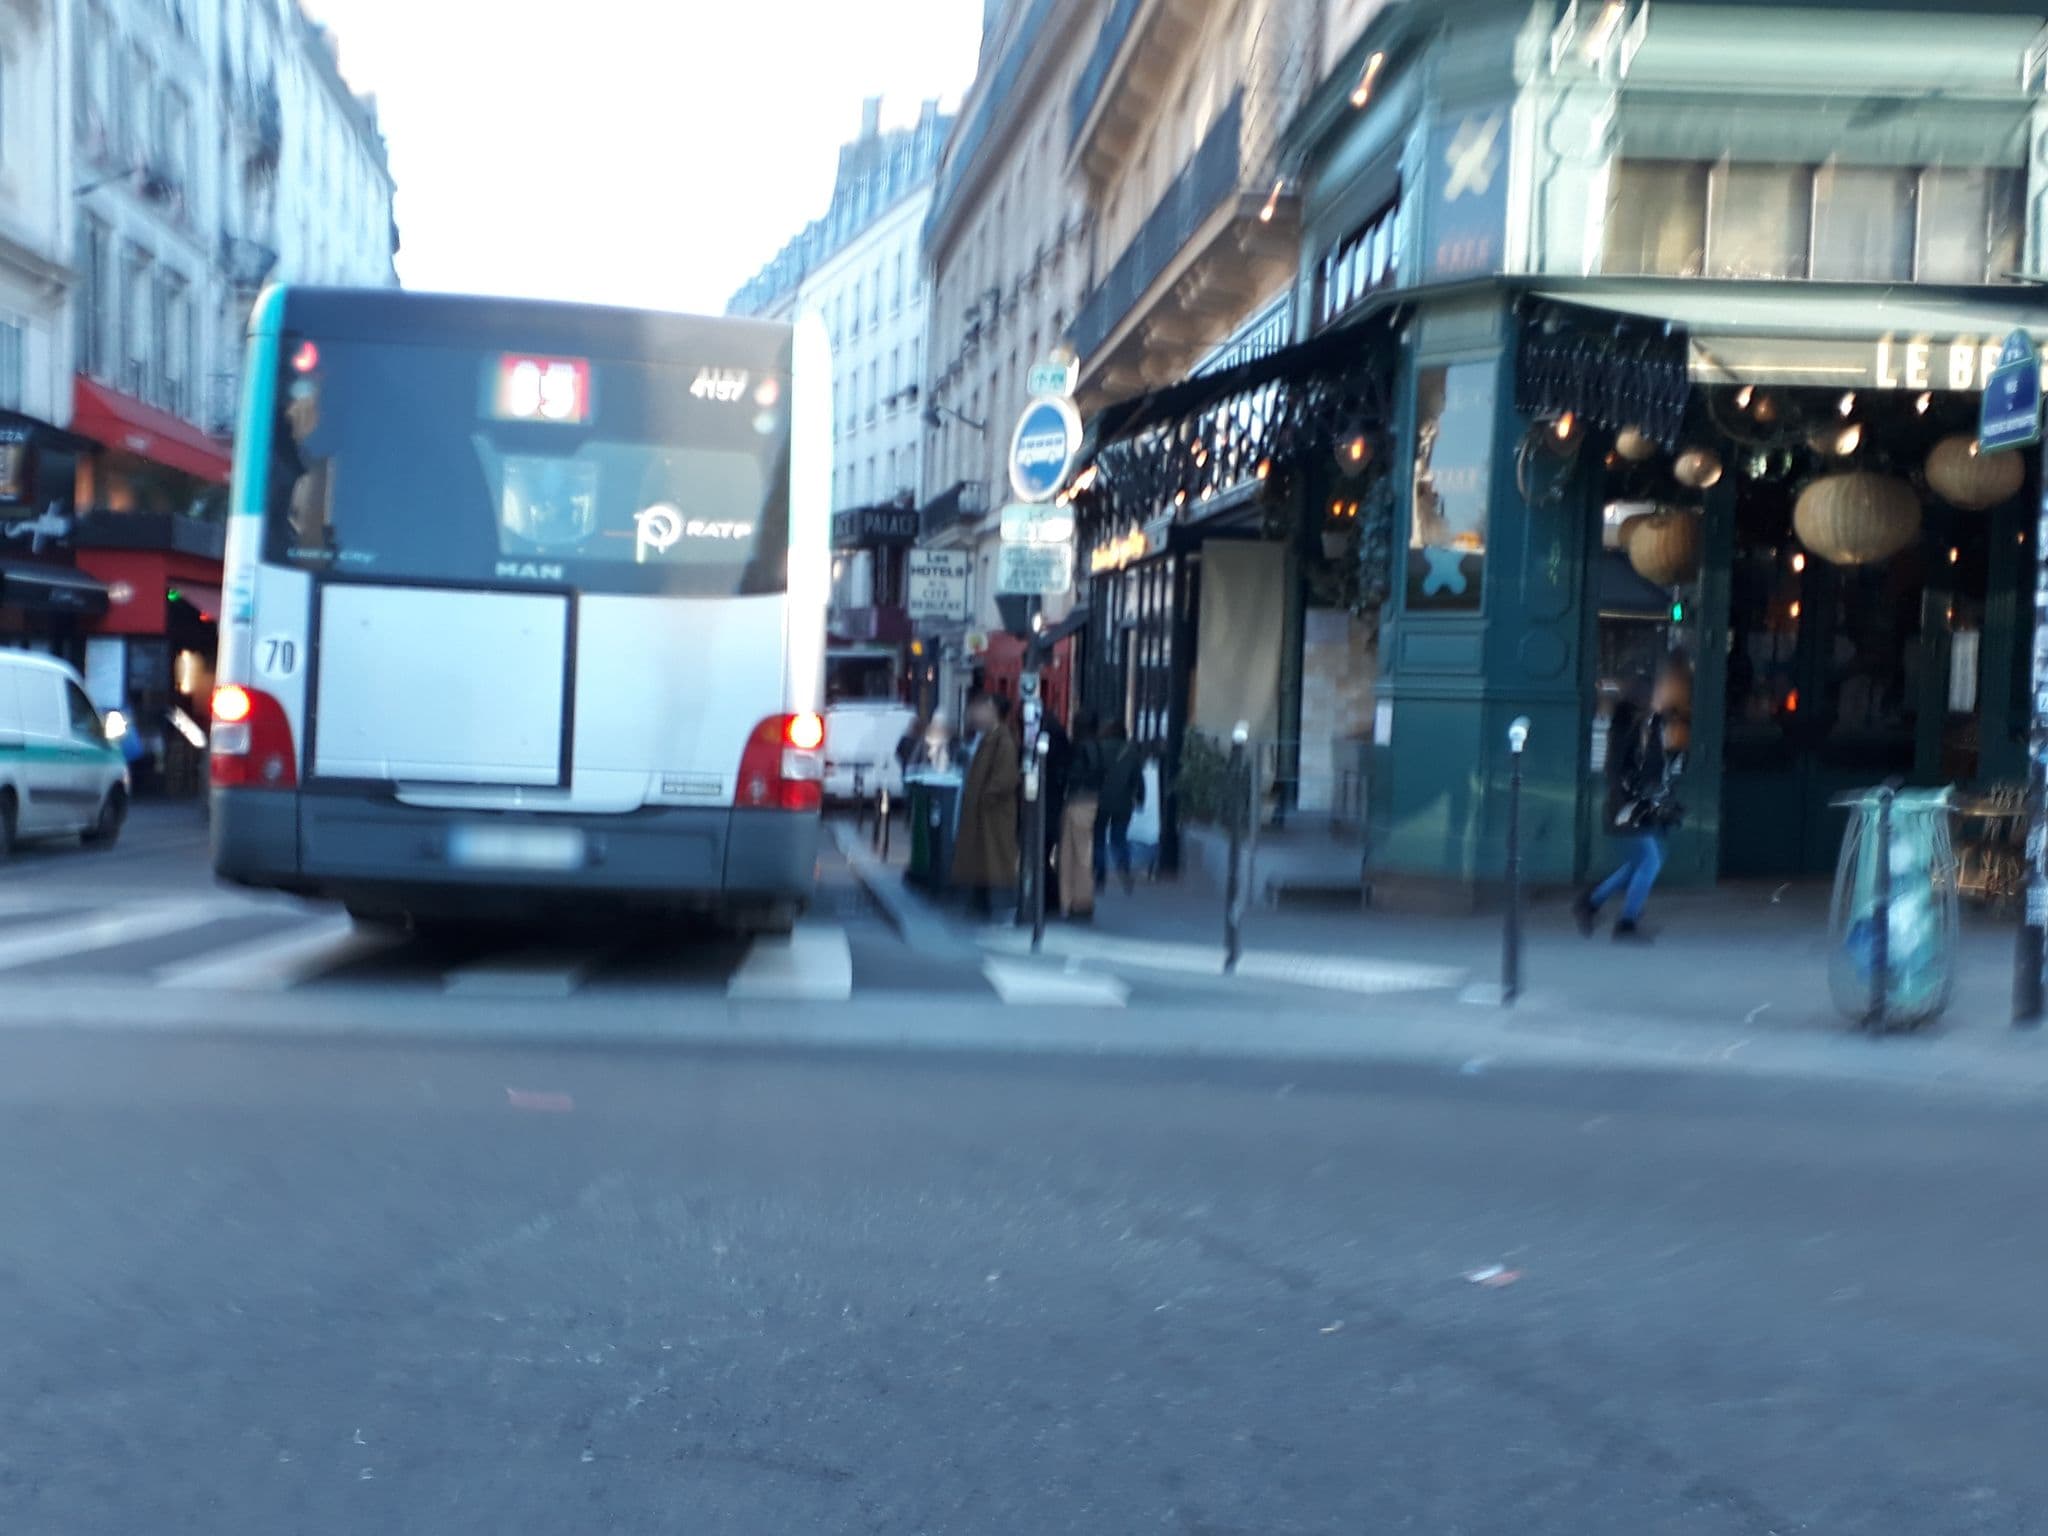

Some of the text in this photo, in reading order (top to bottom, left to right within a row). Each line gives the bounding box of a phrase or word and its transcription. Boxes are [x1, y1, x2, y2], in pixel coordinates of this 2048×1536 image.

[1876, 341, 1930, 389] LE
[686, 521, 752, 539] RATP
[495, 561, 563, 579] MAN
[264, 639, 296, 675] 70
